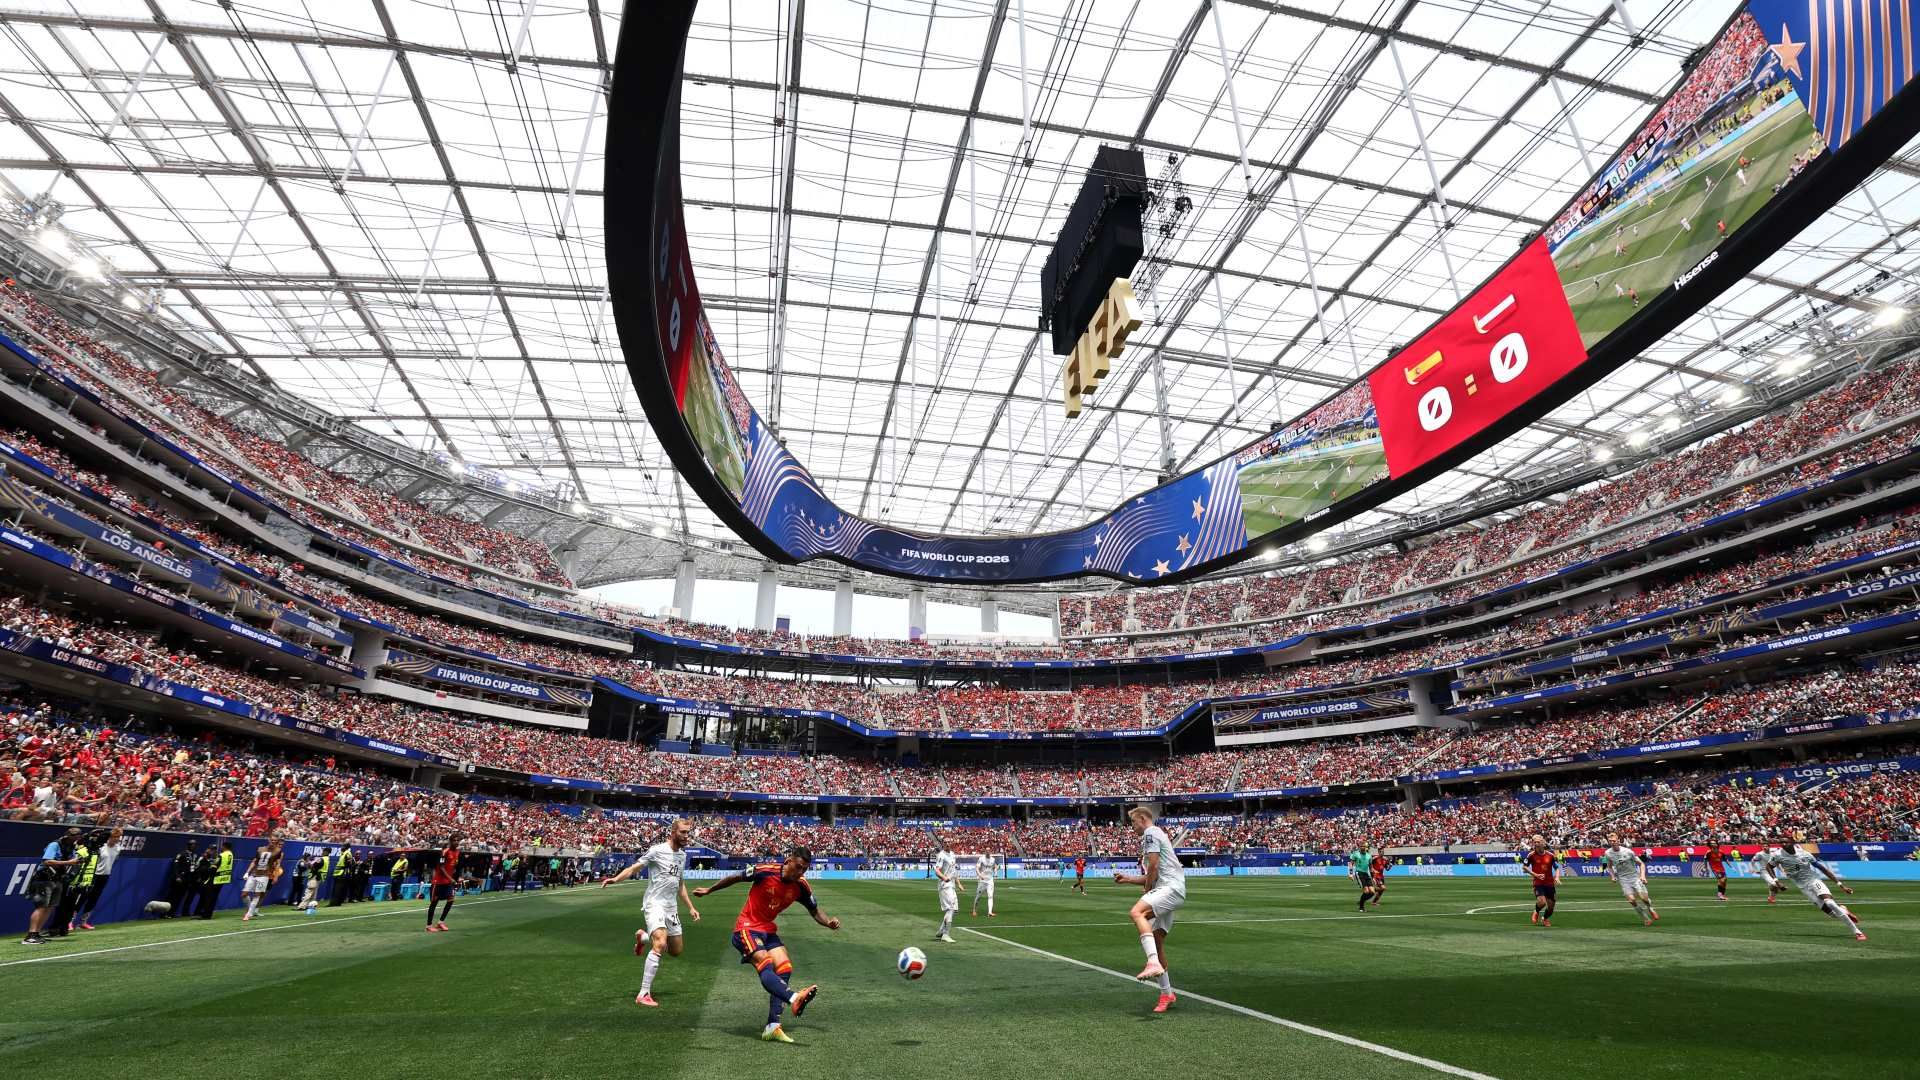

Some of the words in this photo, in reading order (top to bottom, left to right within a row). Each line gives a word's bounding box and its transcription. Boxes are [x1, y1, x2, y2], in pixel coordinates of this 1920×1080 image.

[1674, 251, 1719, 291] Hisense
[1062, 276, 1143, 419] FIFA
[1418, 386, 1453, 432] 0
[1489, 332, 1529, 384] 0
[100, 530, 130, 552] LOS
[131, 546, 192, 578] ANGELES
[902, 549, 920, 558] FIFA
[921, 551, 955, 562] WORLD
[956, 555, 975, 563] CUP
[1847, 582, 1884, 598] LOS
[1783, 636, 1808, 646] WORLD
[1808, 633, 1823, 641] CUP
[51, 649, 69, 661] LOS
[437, 667, 458, 680] FIFA
[459, 671, 492, 686] WORLD
[492, 679, 510, 690] CUP
[510, 683, 540, 696] 2026
[676, 707, 697, 715] WORLD
[1262, 712, 1279, 720] FIFA
[1280, 708, 1309, 717] WORLD
[1310, 705, 1327, 714] CUP
[1328, 702, 1358, 712] 2026
[1794, 768, 1823, 778] LOS
[1542, 791, 1556, 802] FIFA
[1557, 789, 1584, 799] WORLD
[120, 835, 147, 851] ELES
[669, 864, 679, 877] 20
[1485, 864, 1524, 876] POWER
[1647, 865, 1678, 874] 2026
